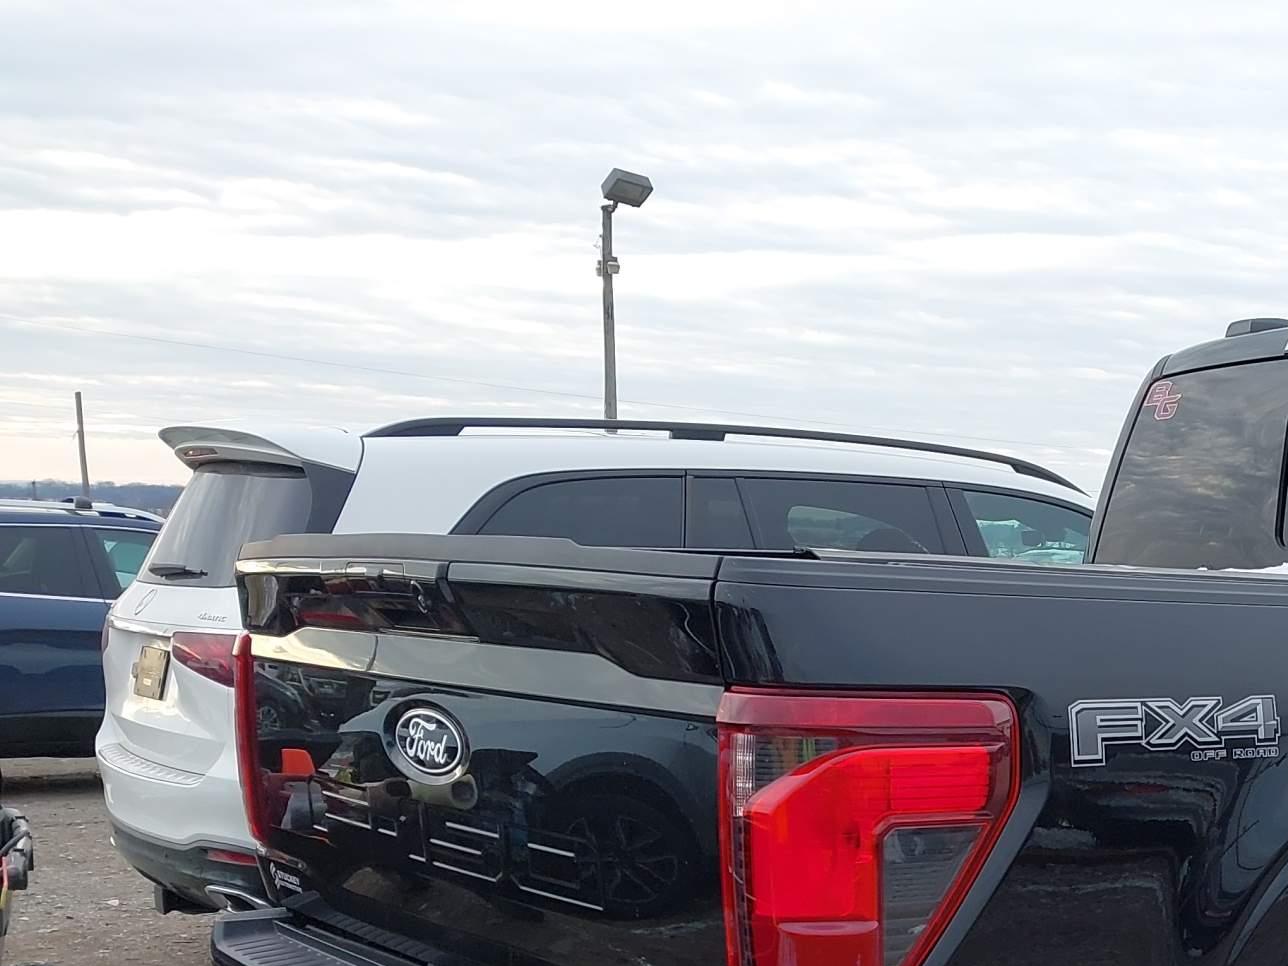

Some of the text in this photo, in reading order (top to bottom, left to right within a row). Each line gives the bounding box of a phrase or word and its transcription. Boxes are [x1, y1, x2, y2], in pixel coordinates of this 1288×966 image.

[406, 717, 448, 764] Ford
[1068, 695, 1280, 767] FX4
[1190, 747, 1279, 762] OFF ROAD
